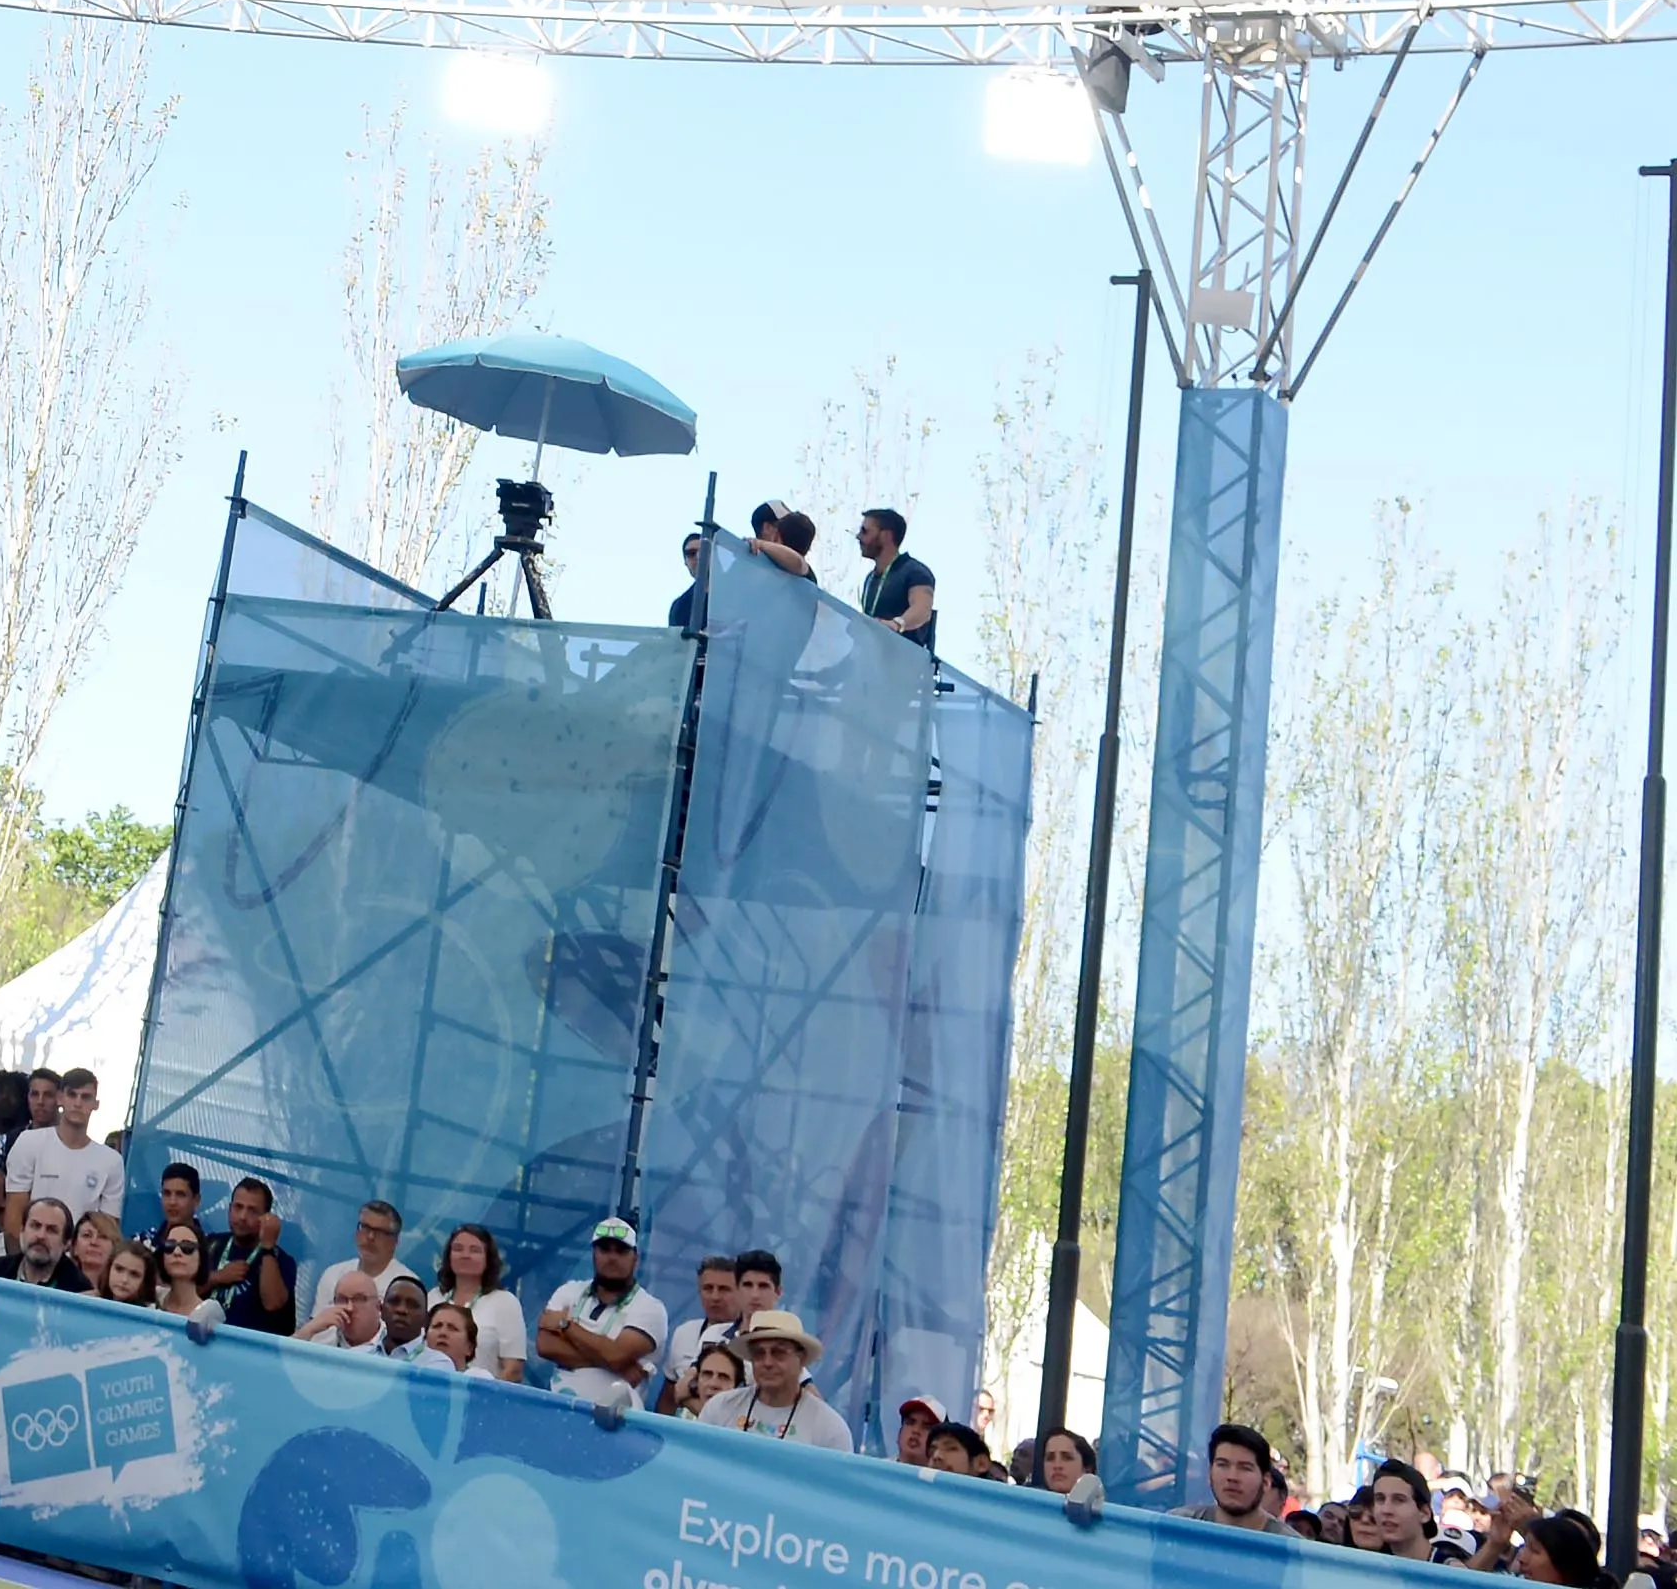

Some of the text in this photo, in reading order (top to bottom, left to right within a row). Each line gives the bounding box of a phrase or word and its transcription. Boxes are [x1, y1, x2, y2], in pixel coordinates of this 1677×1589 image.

[101, 1374, 154, 1400] YOUTH
[96, 1397, 164, 1425] OLYMPIC
[106, 1422, 161, 1447] GAMES
[679, 1498, 849, 1574] Explore
